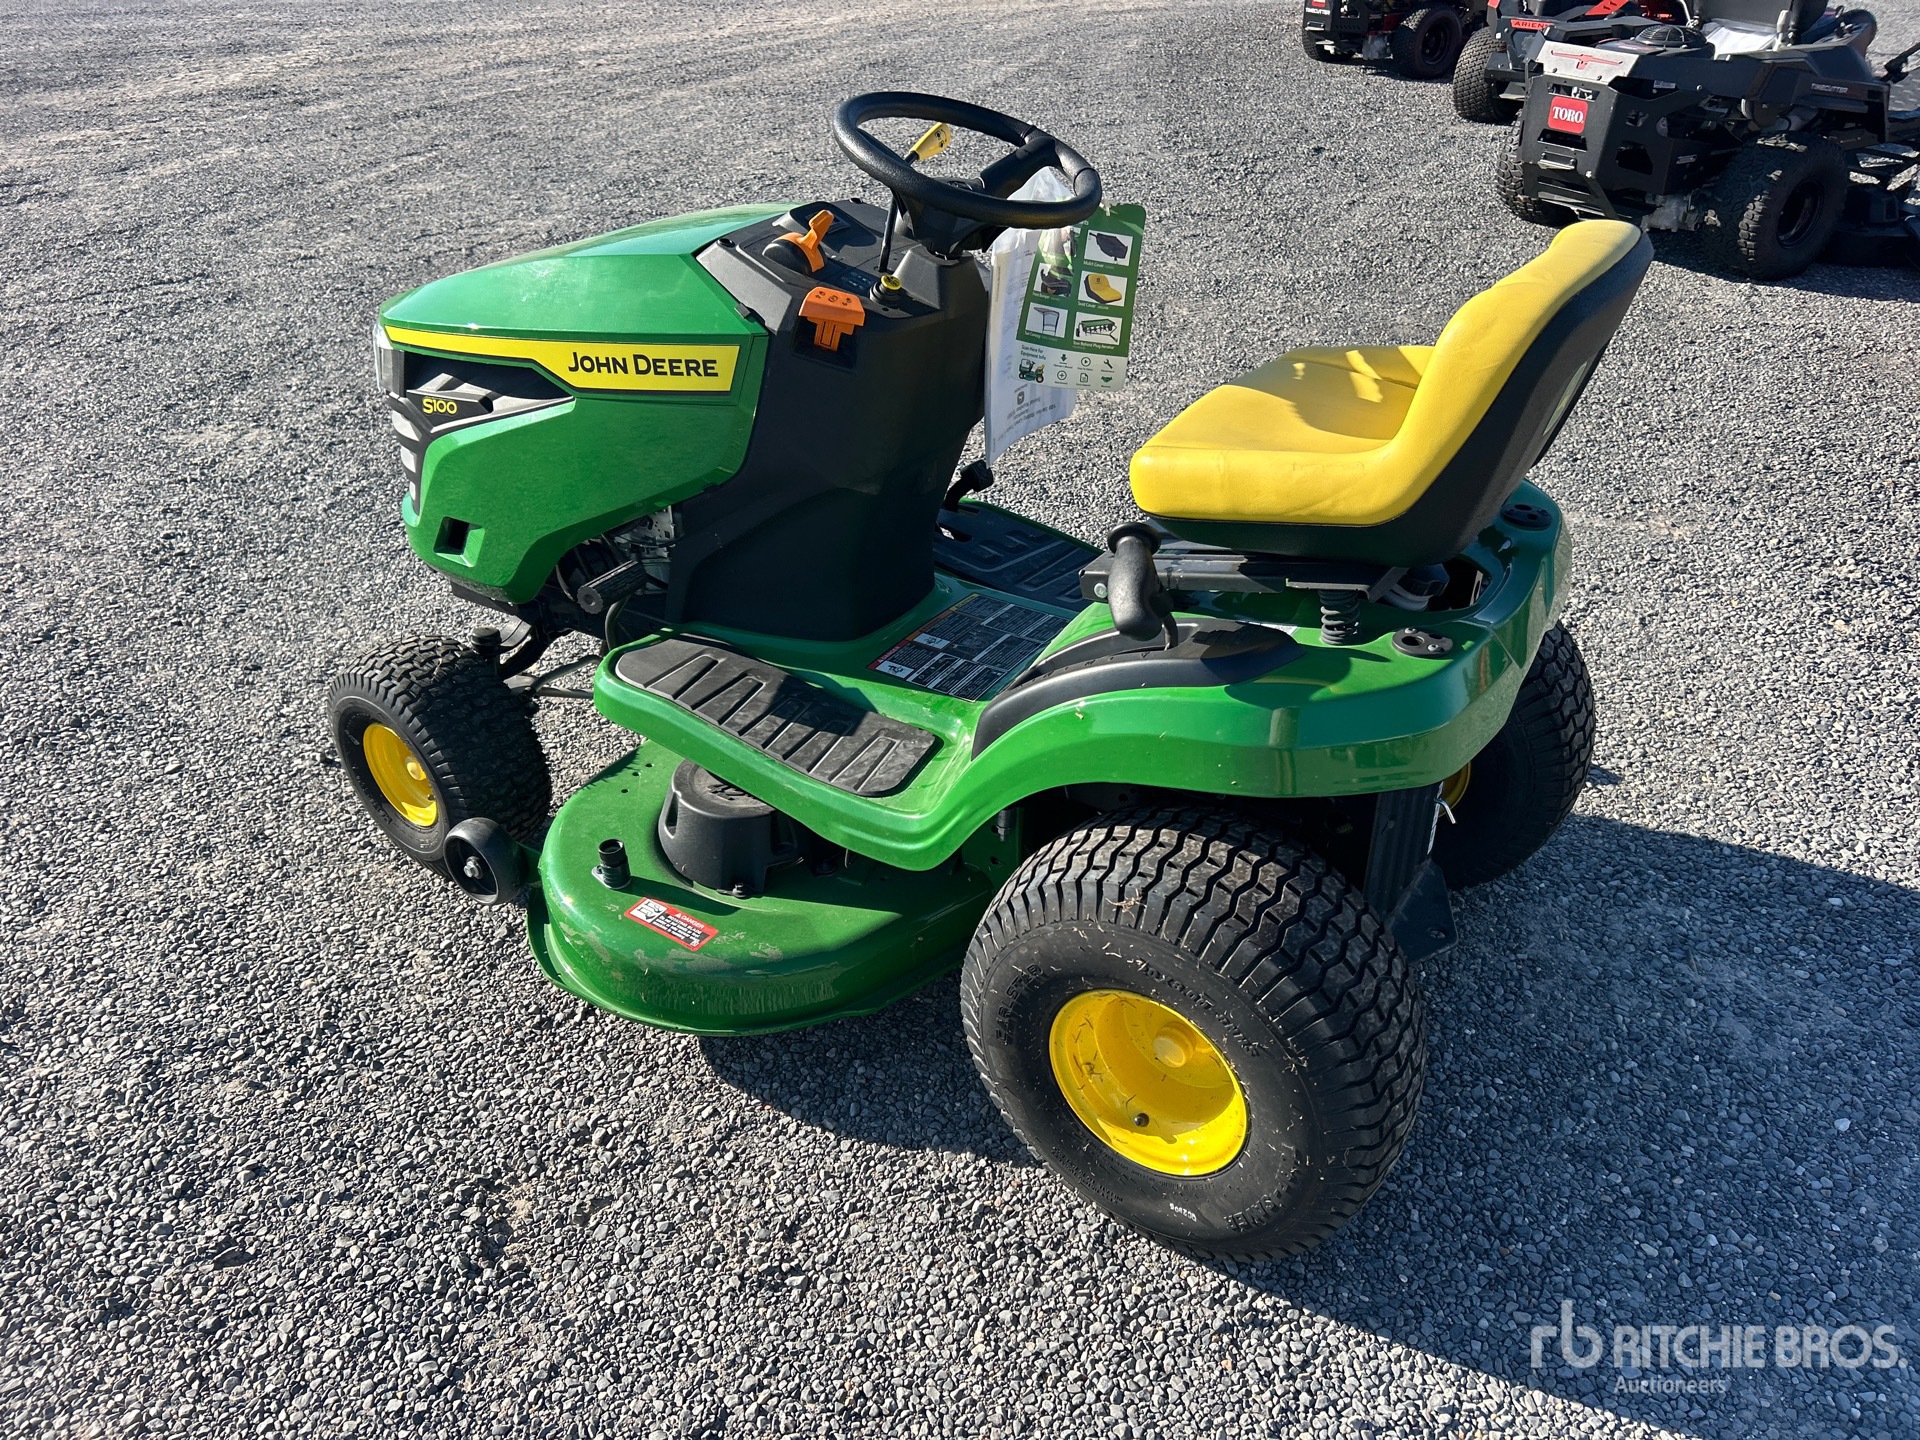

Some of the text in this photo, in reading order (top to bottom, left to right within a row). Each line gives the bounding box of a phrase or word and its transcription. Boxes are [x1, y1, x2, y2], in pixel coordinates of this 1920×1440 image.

[1553, 106, 1584, 123] TORO
[568, 352, 719, 378] JOHN DEERE
[422, 397, 458, 415] S100
[679, 915, 705, 929] DANGER
[996, 964, 1042, 1040] CARLSTAR
